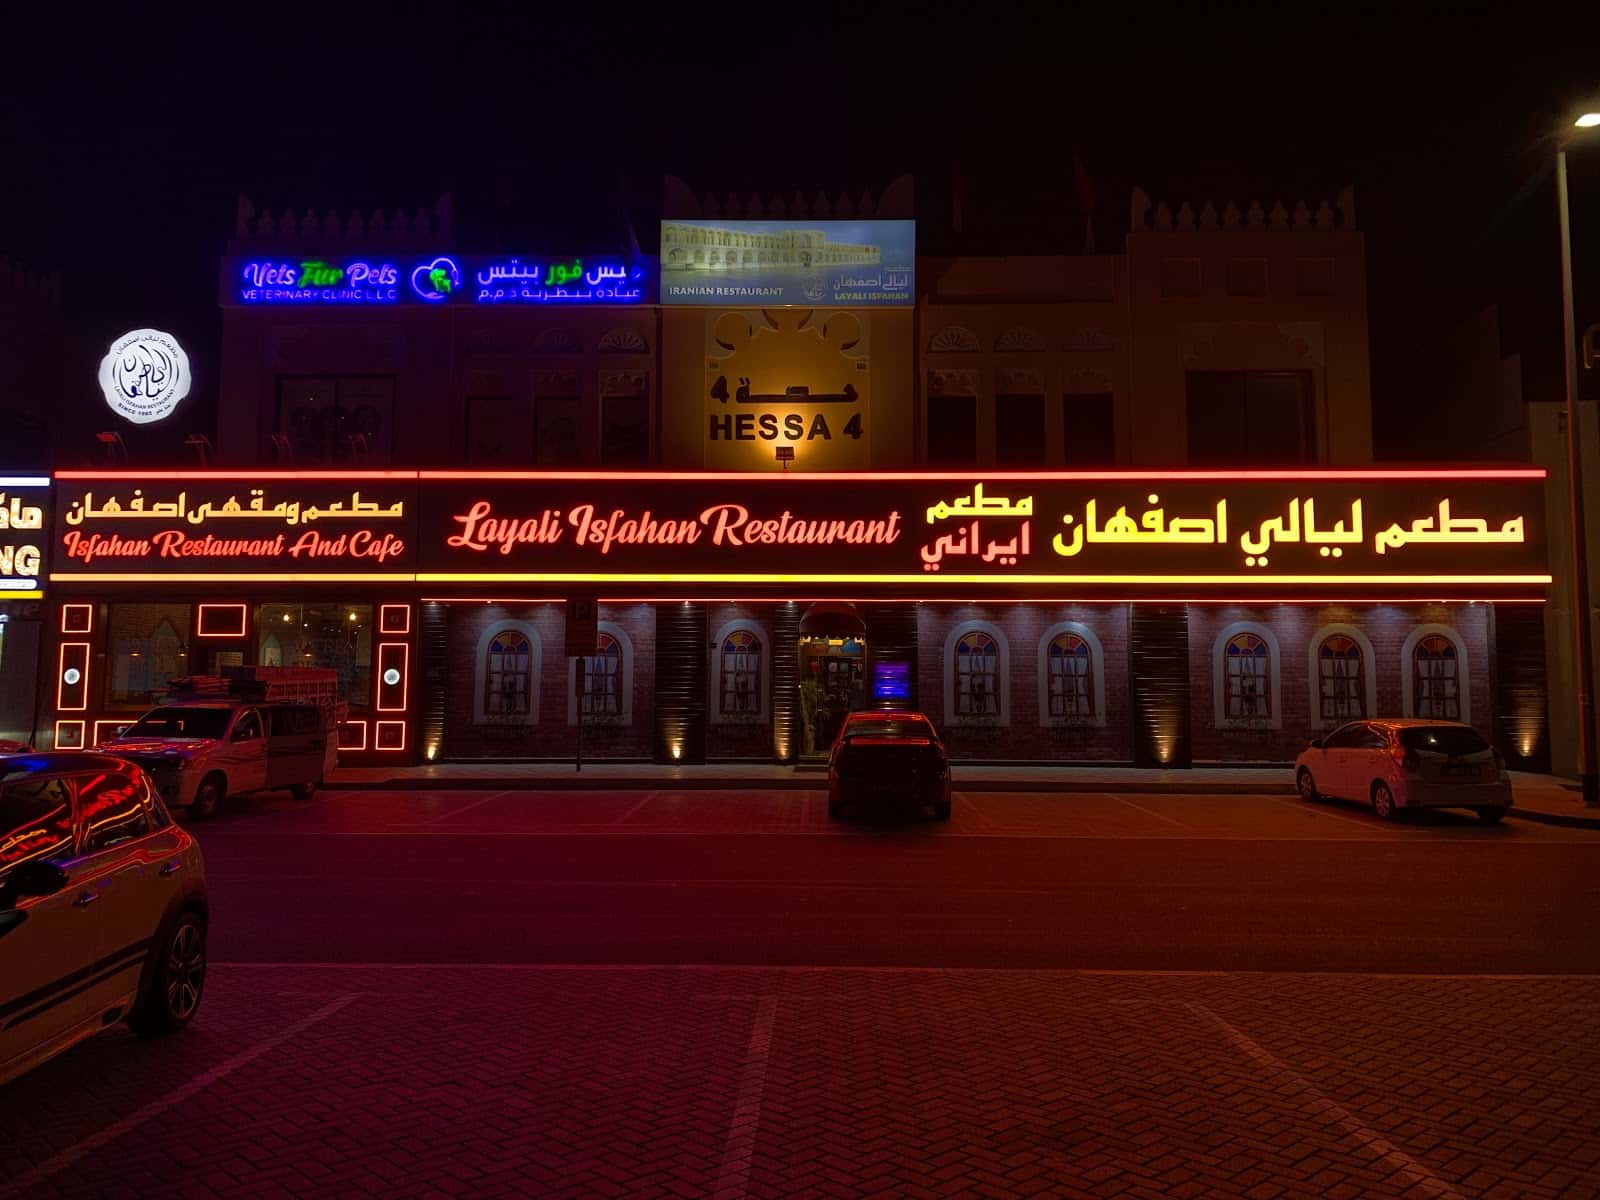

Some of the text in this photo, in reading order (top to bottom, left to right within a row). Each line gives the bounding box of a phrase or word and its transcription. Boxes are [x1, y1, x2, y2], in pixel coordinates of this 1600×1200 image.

[243, 261, 398, 288] Vets Fur Pets
[477, 259, 539, 285] بيتس
[544, 259, 583, 286] فور
[322, 290, 361, 299] CLINIC
[669, 287, 784, 296] IRANIAN RESTAURANT
[710, 376, 858, 404] حصة 4
[709, 413, 864, 440] HESSA 4
[65, 490, 403, 526] مطعم ومقهى اصفهان
[926, 482, 1033, 525] مطعم
[447, 501, 901, 555] Layali Isfahan Restaurant
[1052, 494, 1525, 567] مطعم ليالي اصفهان
[63, 530, 404, 563] Isfahan Restaurant And Cafe
[920, 520, 1030, 571] ايراني
